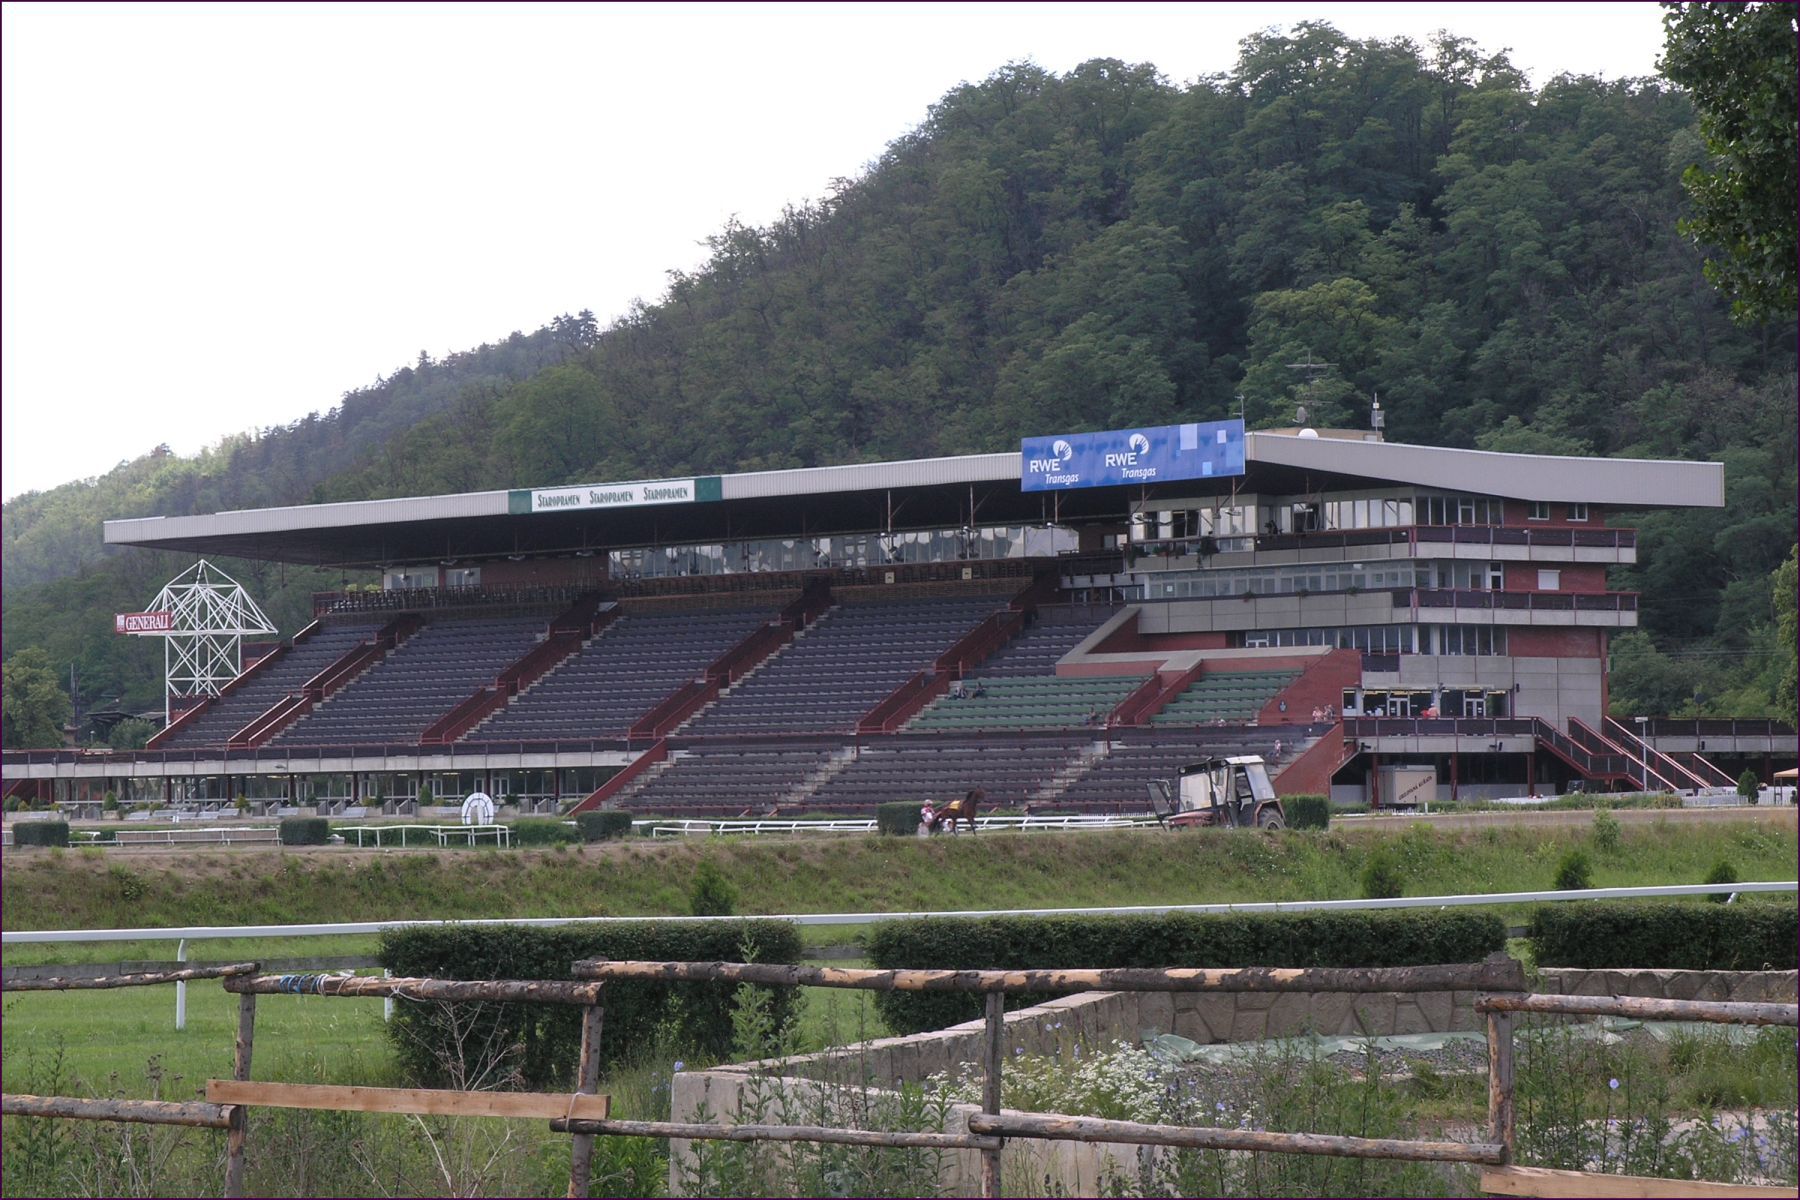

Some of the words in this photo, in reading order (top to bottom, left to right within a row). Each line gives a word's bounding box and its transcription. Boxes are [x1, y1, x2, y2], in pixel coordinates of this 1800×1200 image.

[1030, 459, 1061, 473] RWE
[1105, 452, 1137, 467] RWE
[1045, 473, 1079, 486] Transgas
[1122, 467, 1156, 480] Transgas
[537, 494, 581, 508] STAROPRAMEN
[589, 490, 633, 504] STAROPRAMEN
[643, 486, 688, 502] STAROPRAMEN
[126, 615, 169, 630] GENERALI
